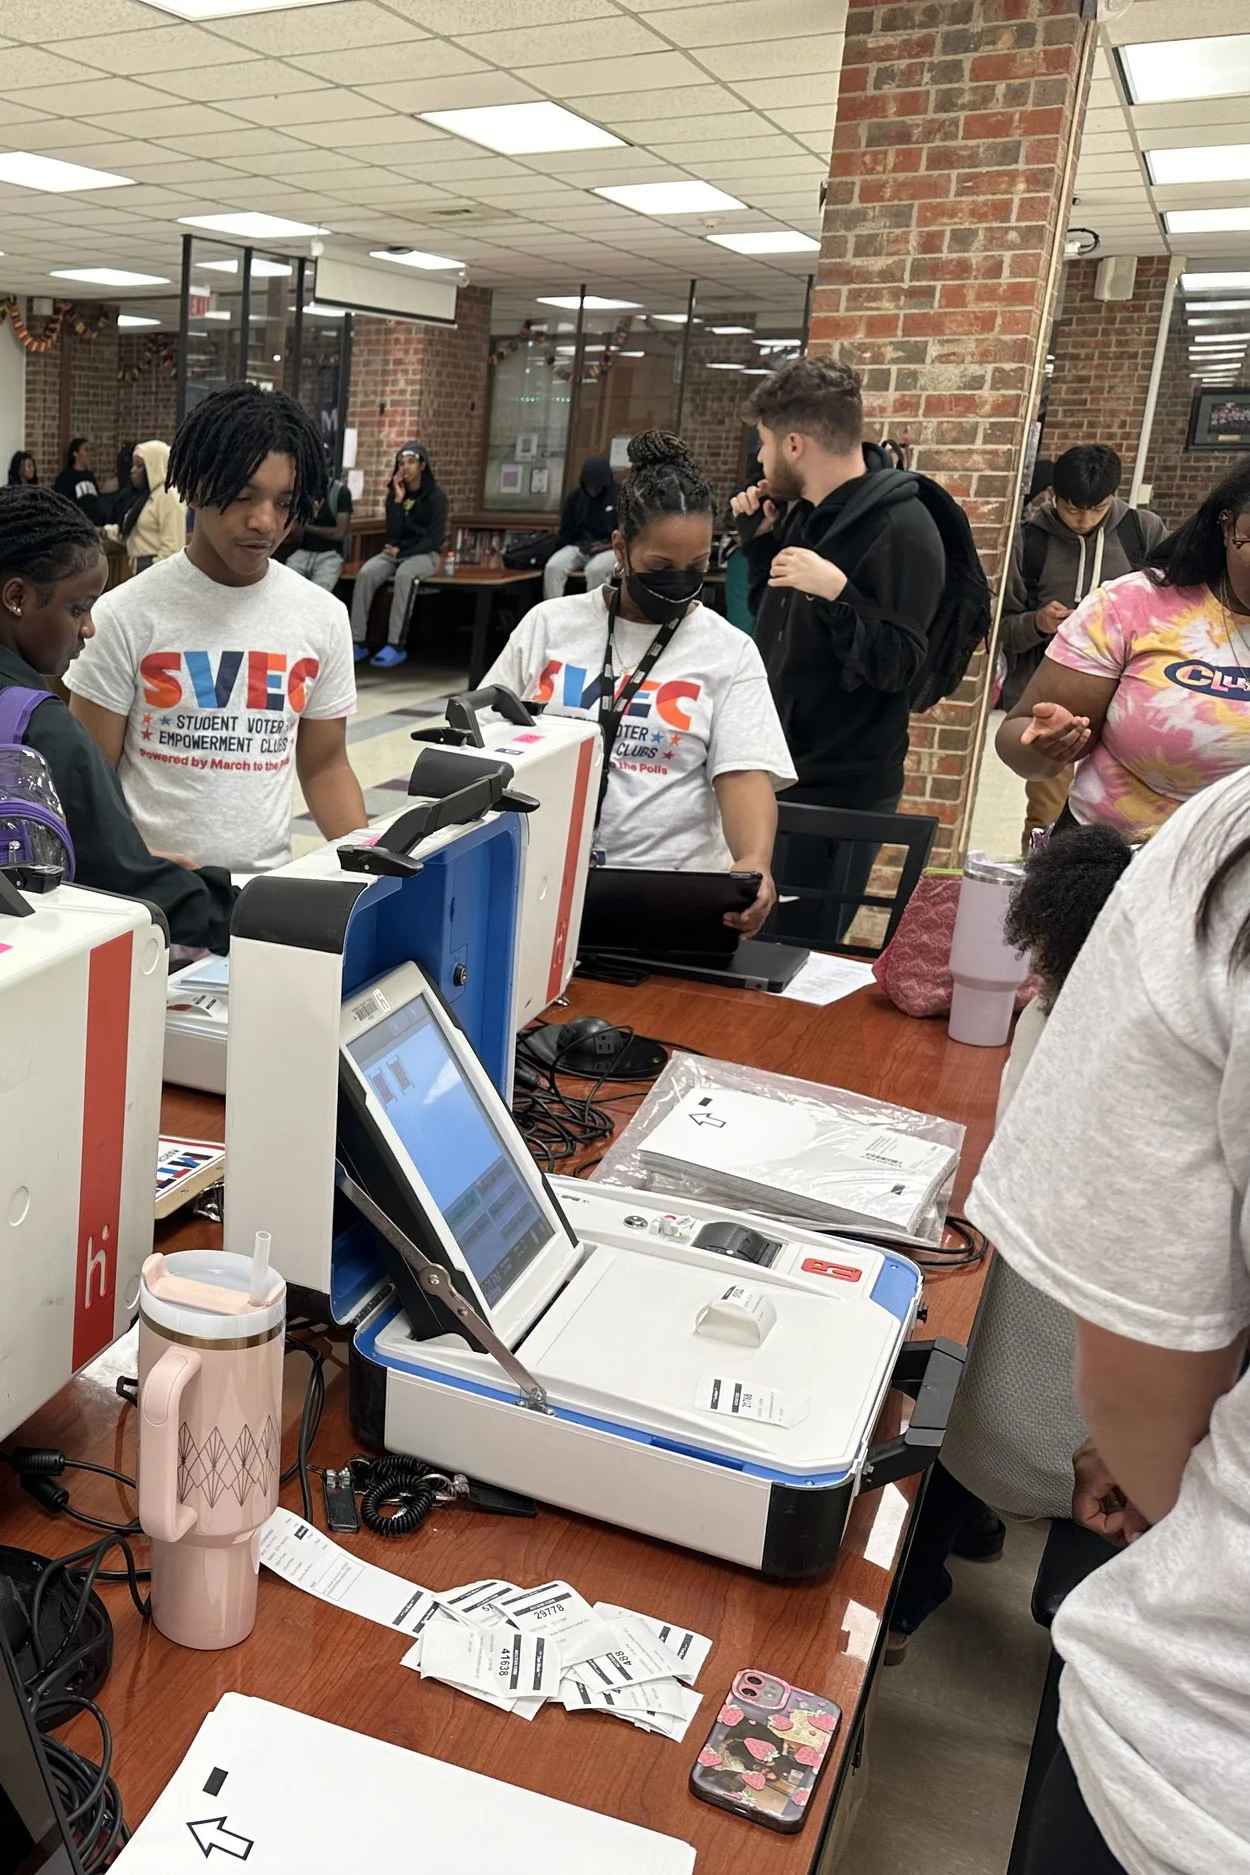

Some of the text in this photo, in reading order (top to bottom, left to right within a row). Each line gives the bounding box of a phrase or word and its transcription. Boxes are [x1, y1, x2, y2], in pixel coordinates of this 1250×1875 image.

[139, 650, 320, 713] SVEC
[176, 714, 285, 734] STUDENT VOTER
[158, 730, 288, 753] EMPOWERMENT CLUBS
[615, 742, 658, 759] CLUBS
[139, 748, 190, 767] Powered
[191, 755, 207, 769] by
[210, 758, 250, 771] March
[253, 760, 263, 771] to
[265, 759, 278, 770] the
[619, 760, 637, 772] the
[639, 761, 668, 775] Polls
[533, 1603, 565, 1620] 29778
[498, 1648, 511, 1677] 41638
[614, 1650, 632, 1667] 488
